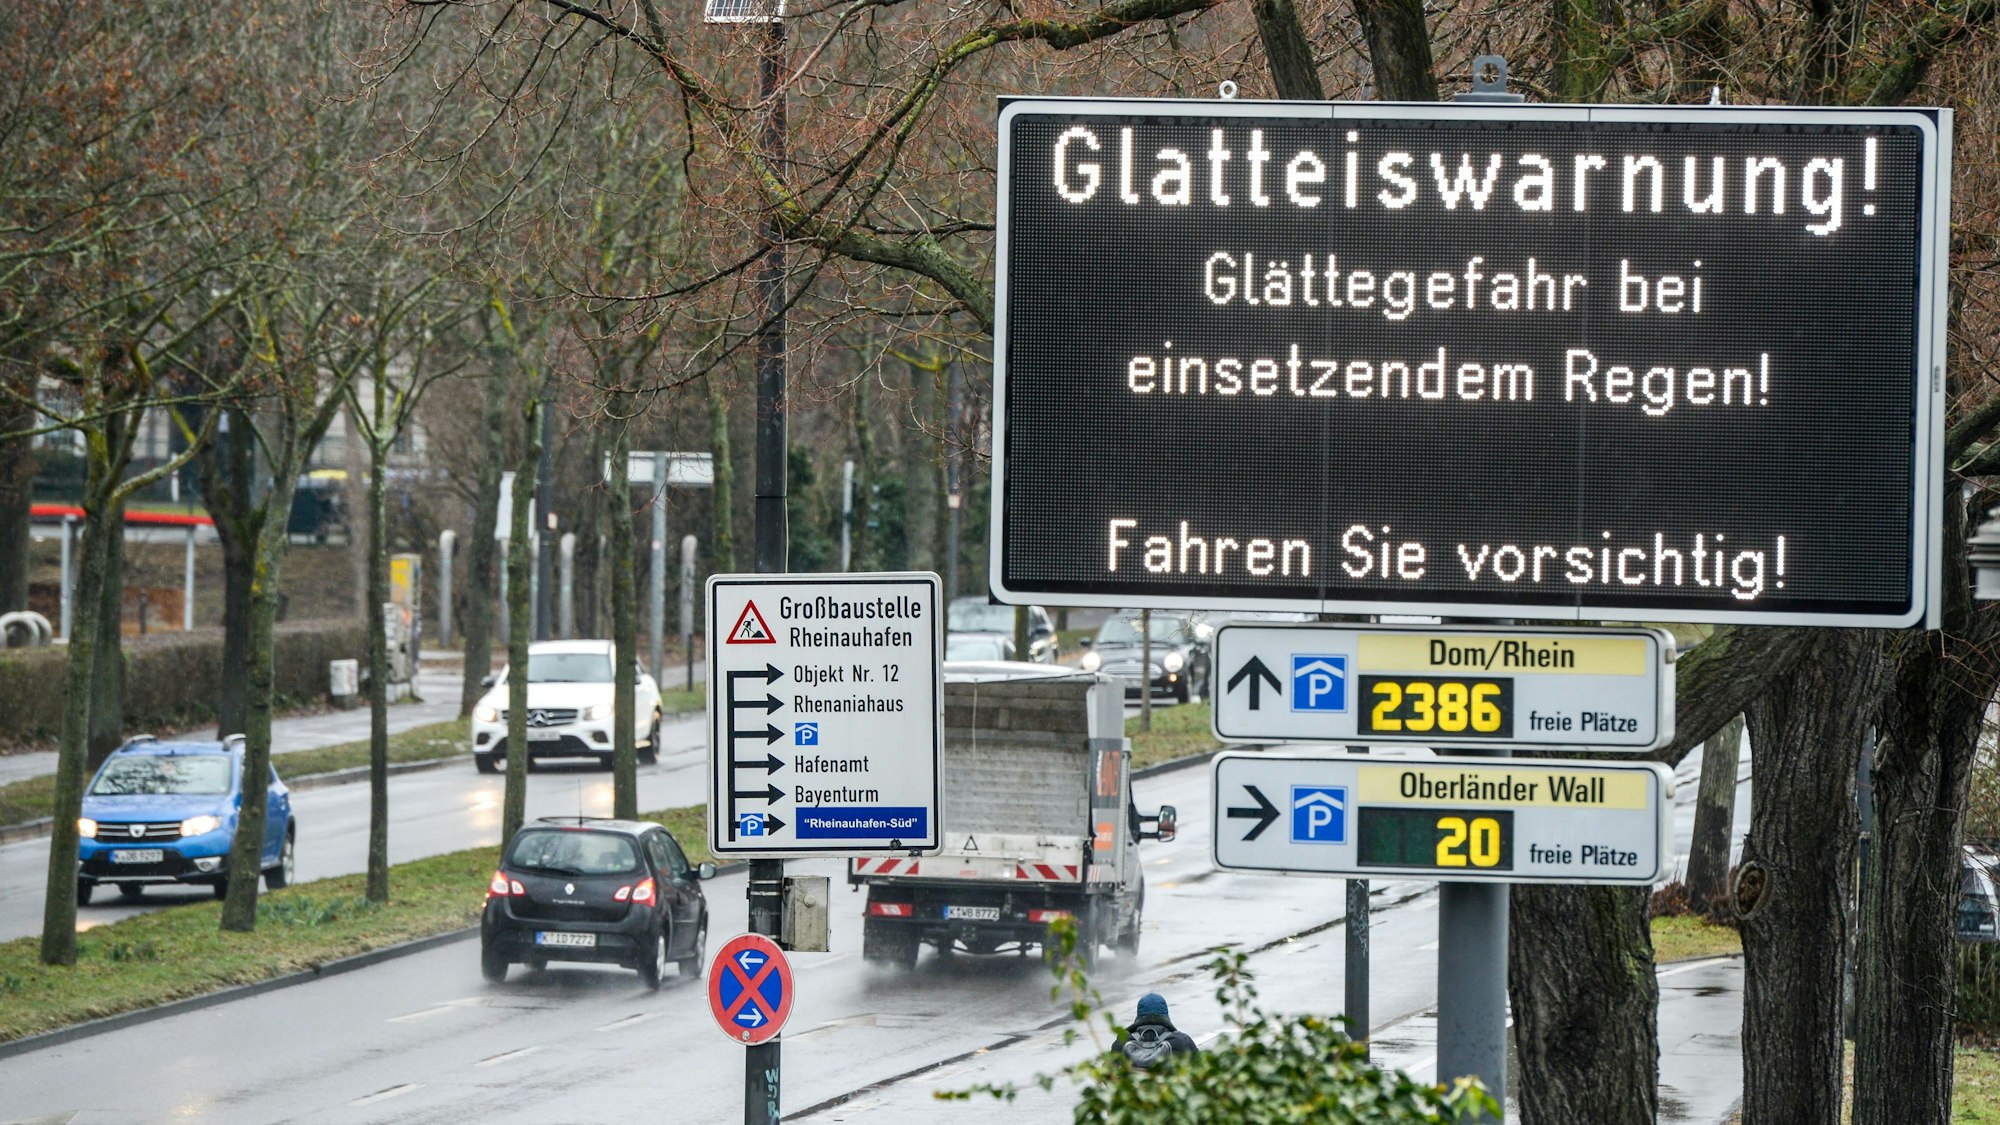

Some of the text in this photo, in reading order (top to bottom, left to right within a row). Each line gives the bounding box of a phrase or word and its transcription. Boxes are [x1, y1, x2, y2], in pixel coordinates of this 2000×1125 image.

[1053, 126, 1879, 236] Glatteiswarnung!
[1204, 252, 1703, 321] Glättegefahr bei
[1128, 341, 1770, 416] einsetzendem Regen!
[1108, 518, 1787, 601] Fahren Sie vorsichtig!
[780, 596, 922, 619] Großbaustelle
[790, 627, 912, 648] Rheinauhafen
[1430, 640, 1575, 670] Dom/Rhein
[794, 665, 899, 687] Objekt Nr. 12
[794, 695, 904, 713] Rhenaniahaus
[1372, 681, 1501, 732] 2386
[1529, 711, 1638, 733] freie Plätze
[795, 756, 869, 773] Hafenamt
[795, 786, 879, 807] Bayenturm
[1400, 772, 1605, 803] Oberländer Wall
[1436, 816, 1501, 867] 20
[1529, 844, 1638, 867] freie Plätze
